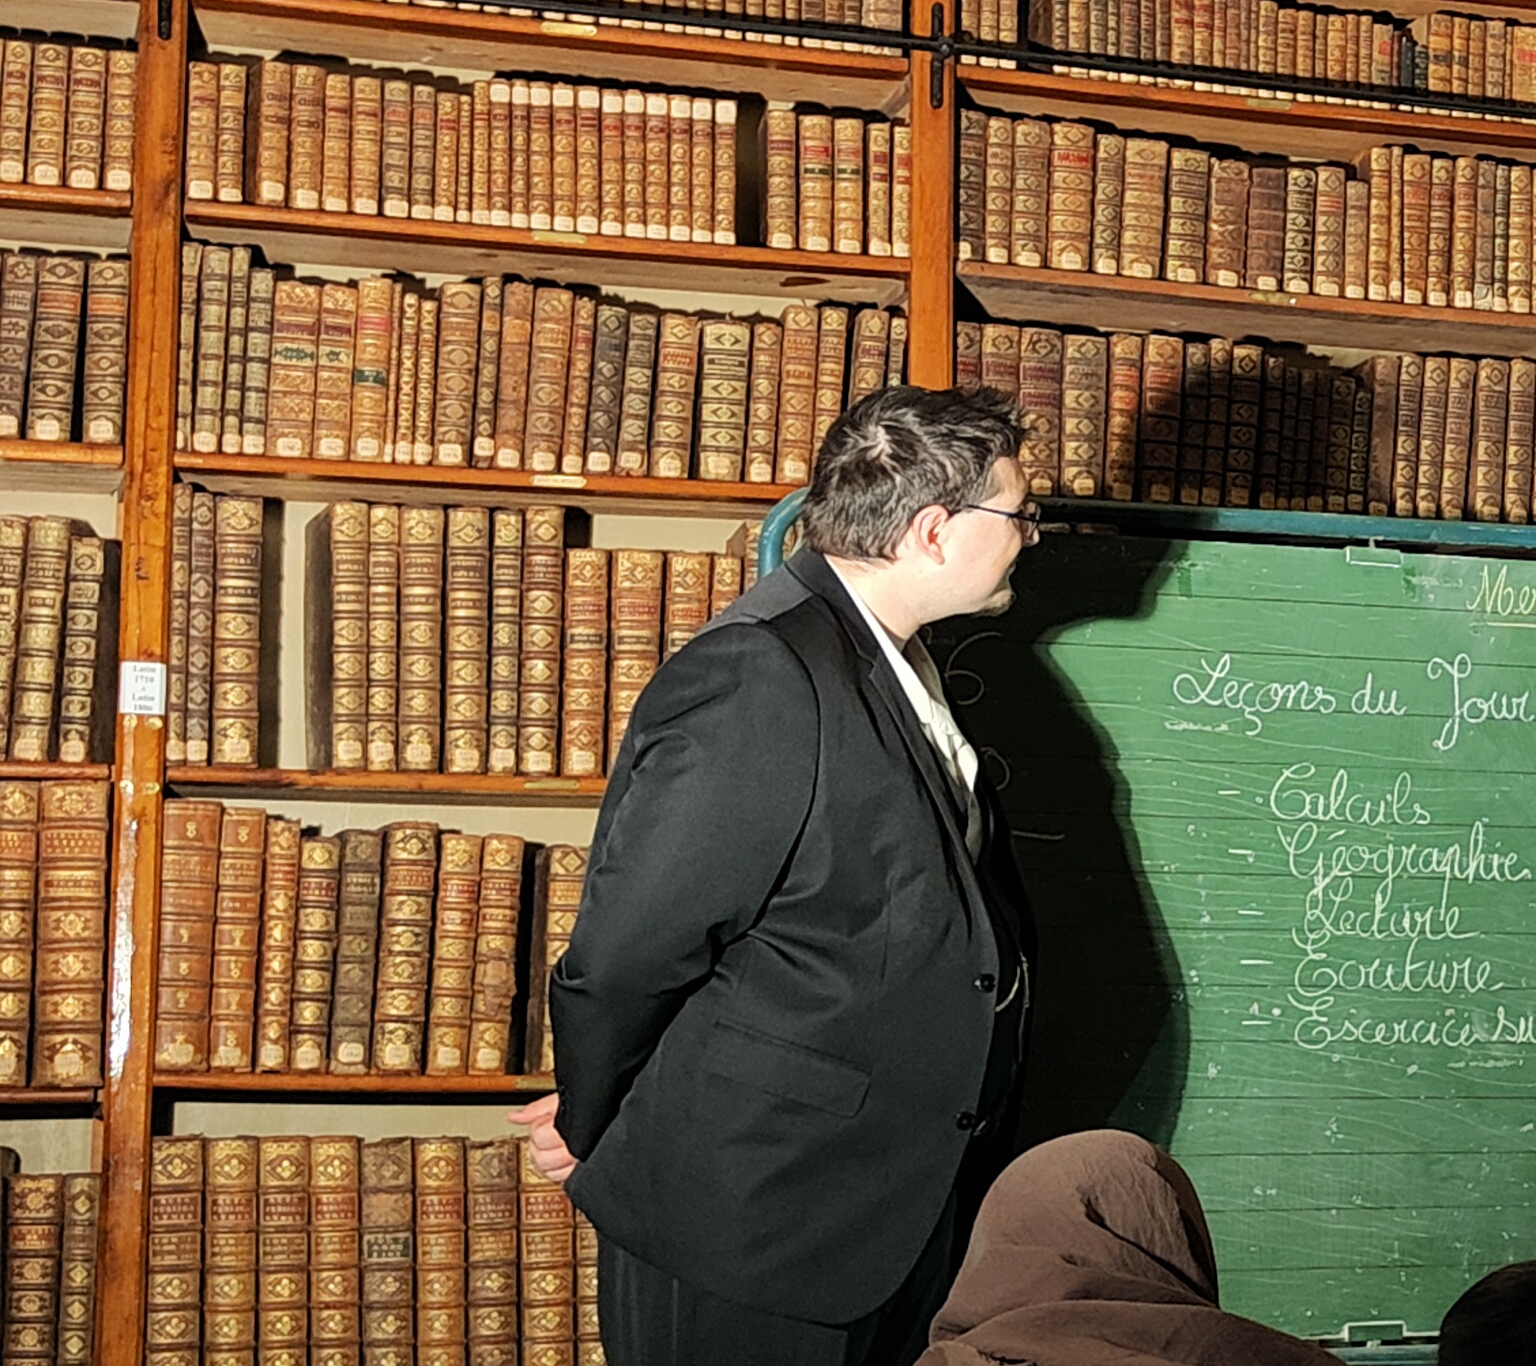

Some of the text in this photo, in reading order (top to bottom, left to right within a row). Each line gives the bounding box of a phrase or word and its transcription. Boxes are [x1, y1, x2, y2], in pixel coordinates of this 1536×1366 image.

[1172, 653, 1536, 751] Leçons du Jour
[1276, 820, 1532, 921] Géographie
[1303, 875, 1481, 939] Lecture
